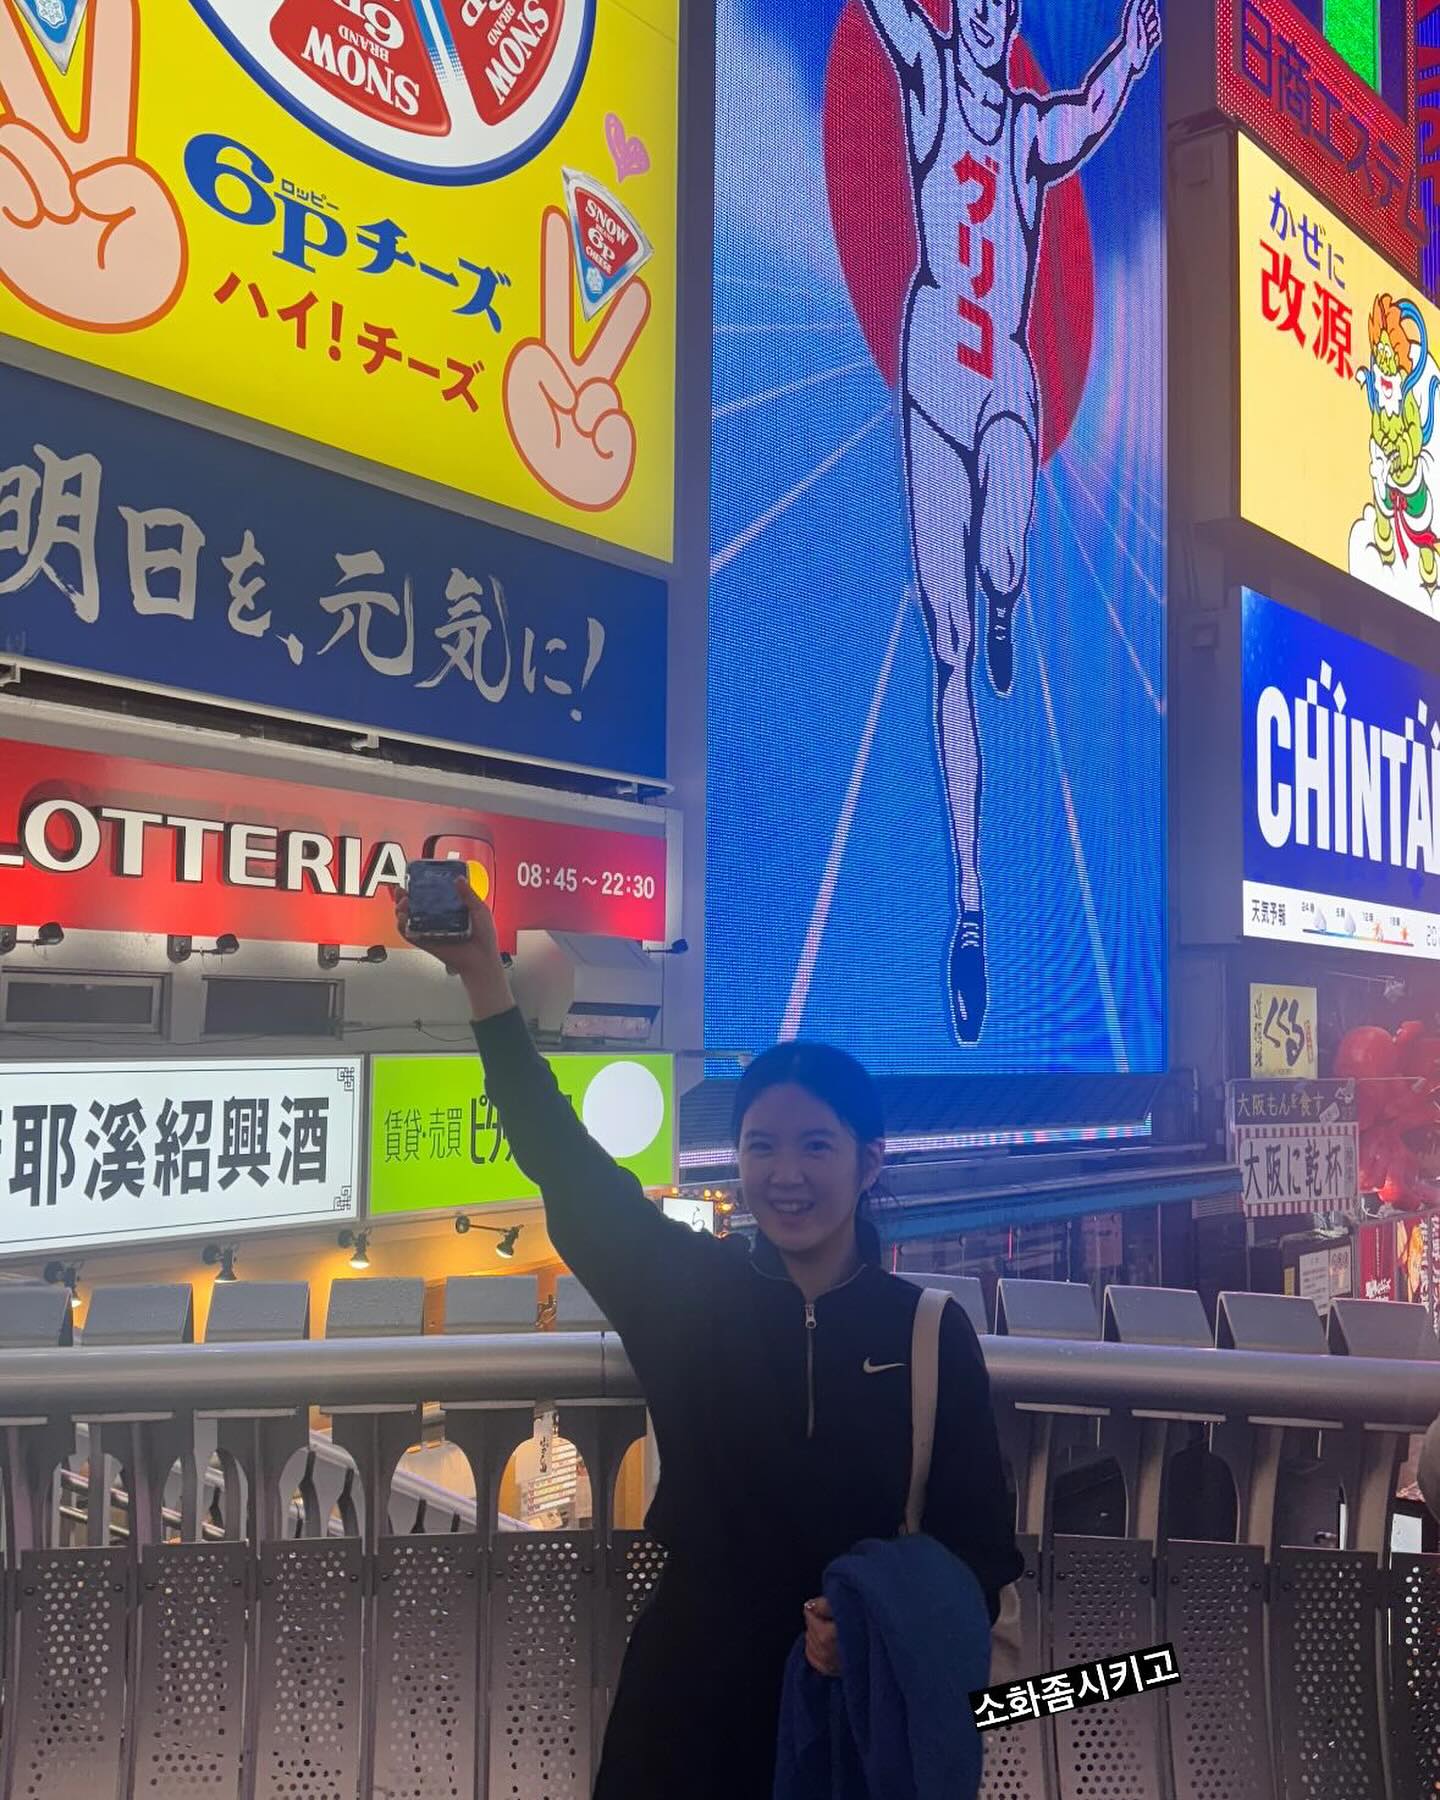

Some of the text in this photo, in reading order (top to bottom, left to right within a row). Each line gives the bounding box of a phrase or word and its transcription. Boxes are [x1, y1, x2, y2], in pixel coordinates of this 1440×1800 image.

[338, 25, 389, 63] BRAND
[485, 0, 549, 105] SNOW
[487, 2, 516, 46] BRAND
[301, 26, 419, 116] SNOW
[281, 178, 339, 210] ロッピー
[585, 199, 629, 245] SNOW
[585, 245, 612, 275] CHEESE
[952, 150, 999, 380] グリコ
[1269, 187, 1345, 289] かぜに
[1259, 239, 1354, 380] 改源
[213, 271, 485, 413] ハイ!チーズ
[1251, 899, 1286, 927] 天気予報
[0, 1096, 329, 1207] 耶溪紹興酒
[384, 1107, 462, 1164] 賃貸・売買
[1244, 1138, 1342, 1200] 大阪に乾杯
